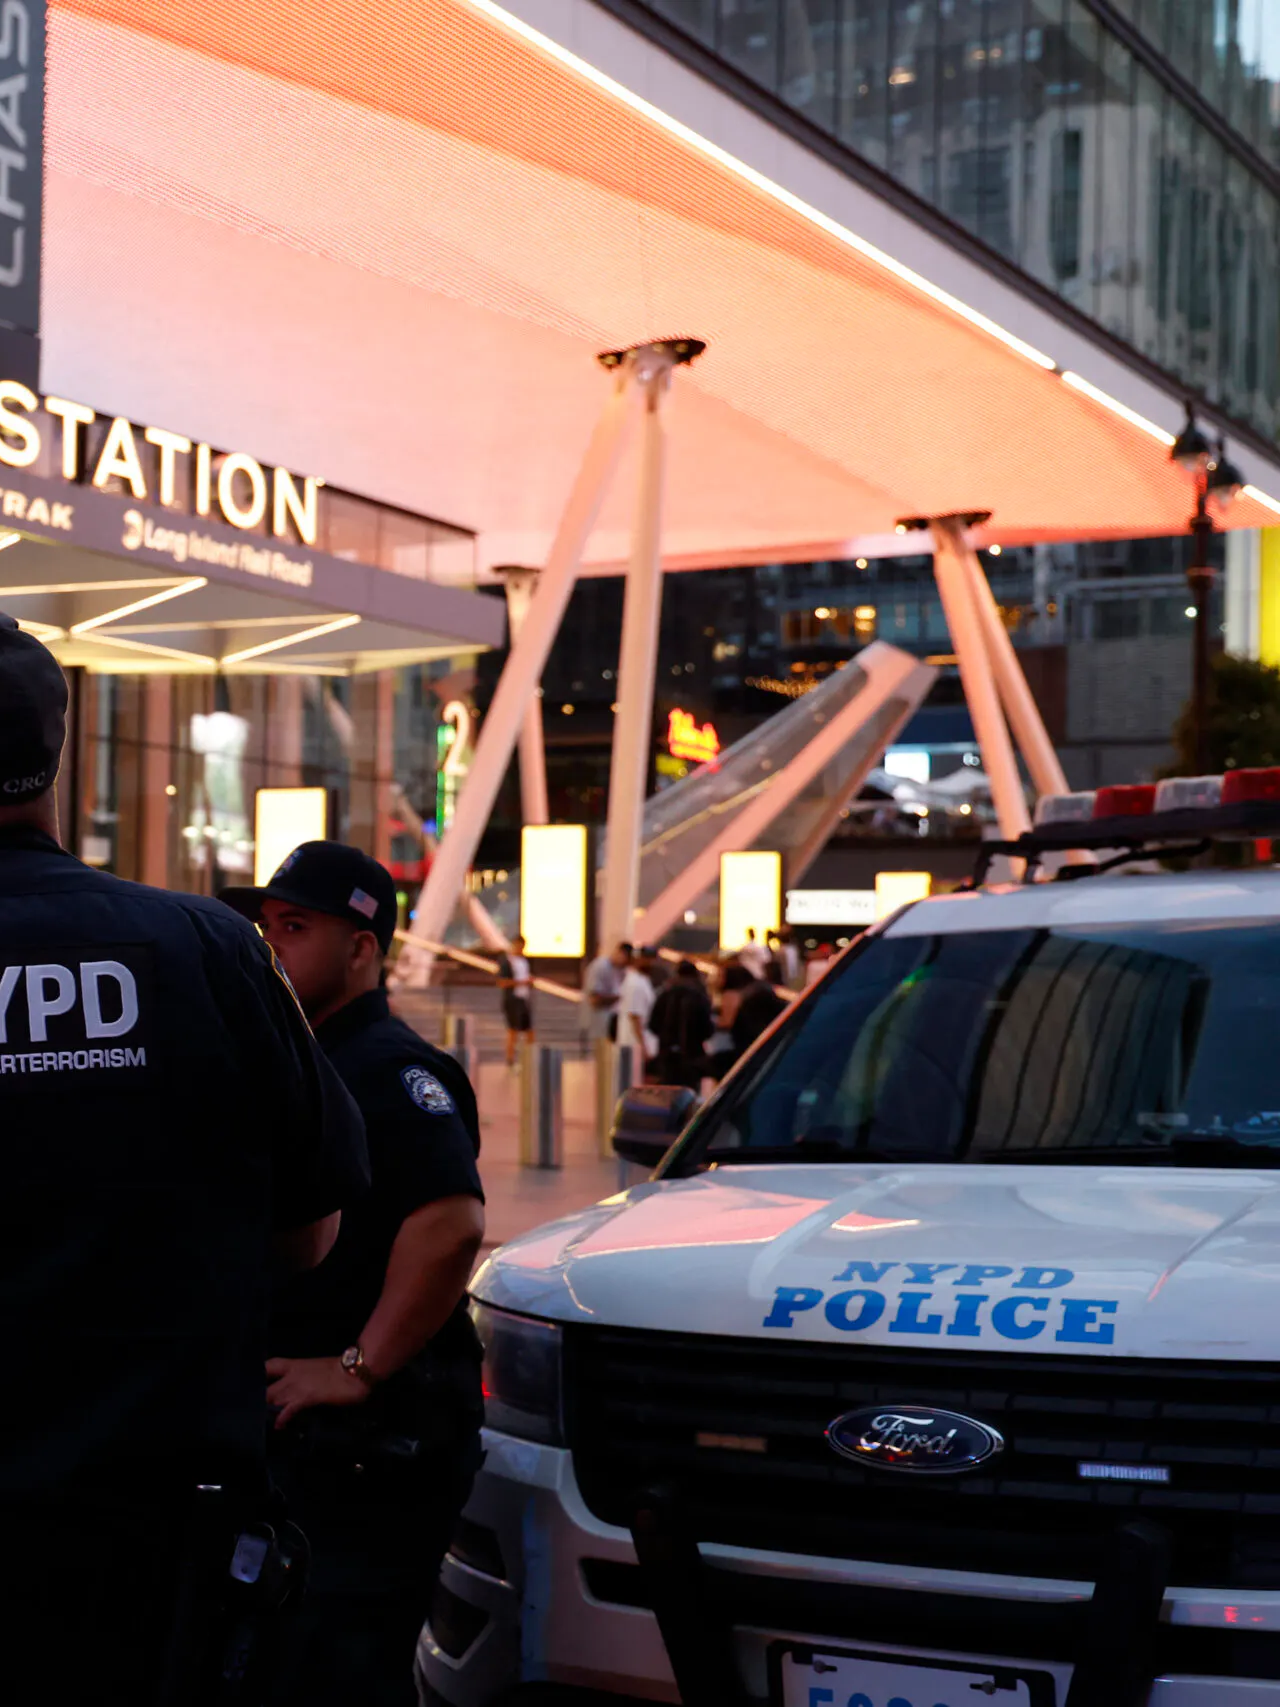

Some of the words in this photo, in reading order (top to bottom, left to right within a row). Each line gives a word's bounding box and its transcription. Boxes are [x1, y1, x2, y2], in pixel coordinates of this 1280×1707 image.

[144, 519, 188, 562] Long
[188, 530, 239, 567] Island
[239, 544, 272, 576] Rail
[271, 551, 312, 587] Road
[832, 1260, 1075, 1290] NYPD
[762, 1286, 1120, 1346] POLICE
[859, 1413, 957, 1454] Ford
